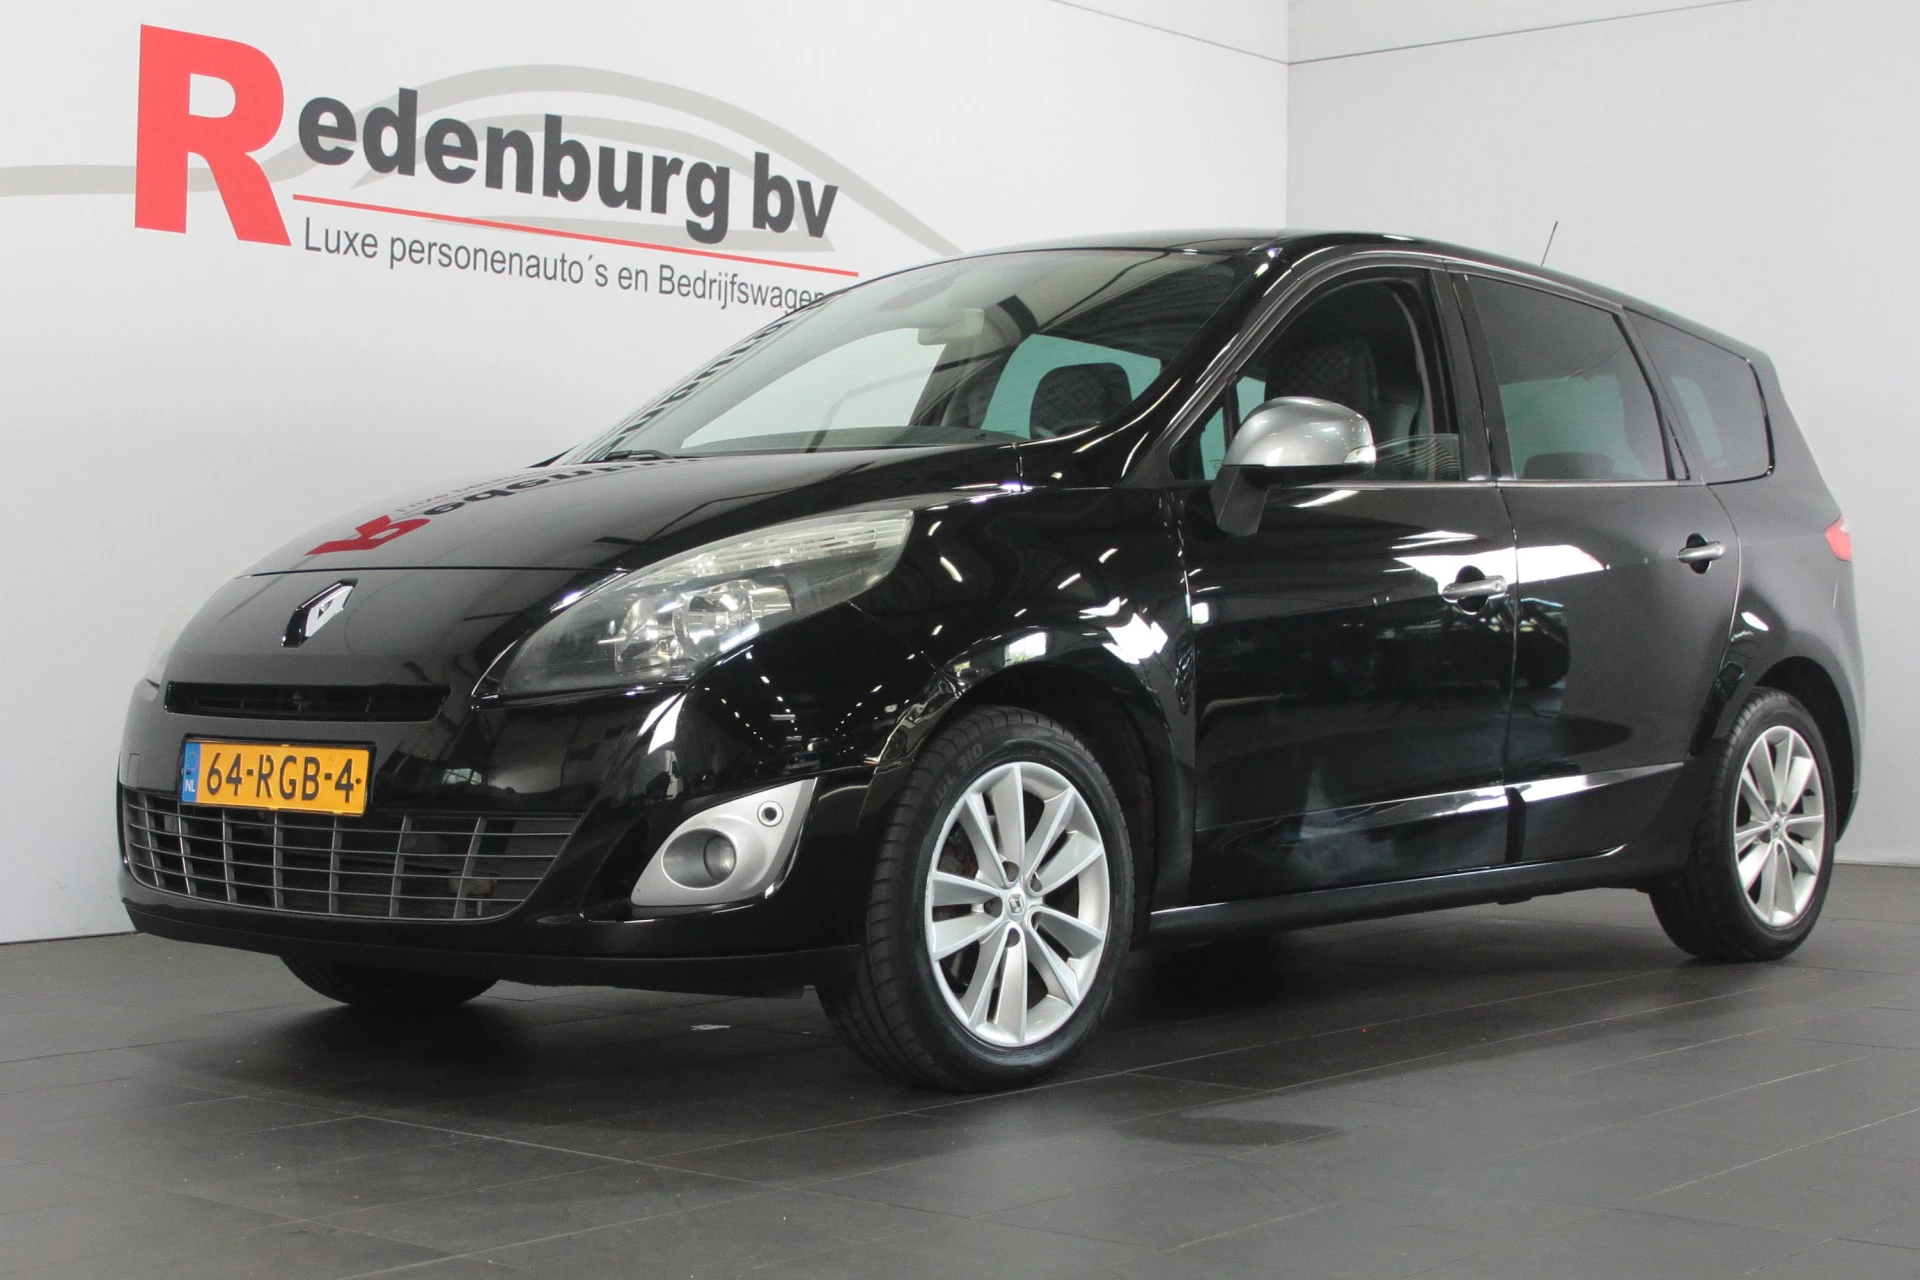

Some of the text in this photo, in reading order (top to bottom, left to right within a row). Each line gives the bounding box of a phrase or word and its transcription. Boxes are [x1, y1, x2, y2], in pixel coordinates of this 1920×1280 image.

[135, 24, 839, 246] Redenburg bv
[305, 217, 379, 259] Luxe
[618, 266, 649, 292] en
[184, 779, 197, 793] NL
[206, 752, 354, 804] 64-RGB-4
